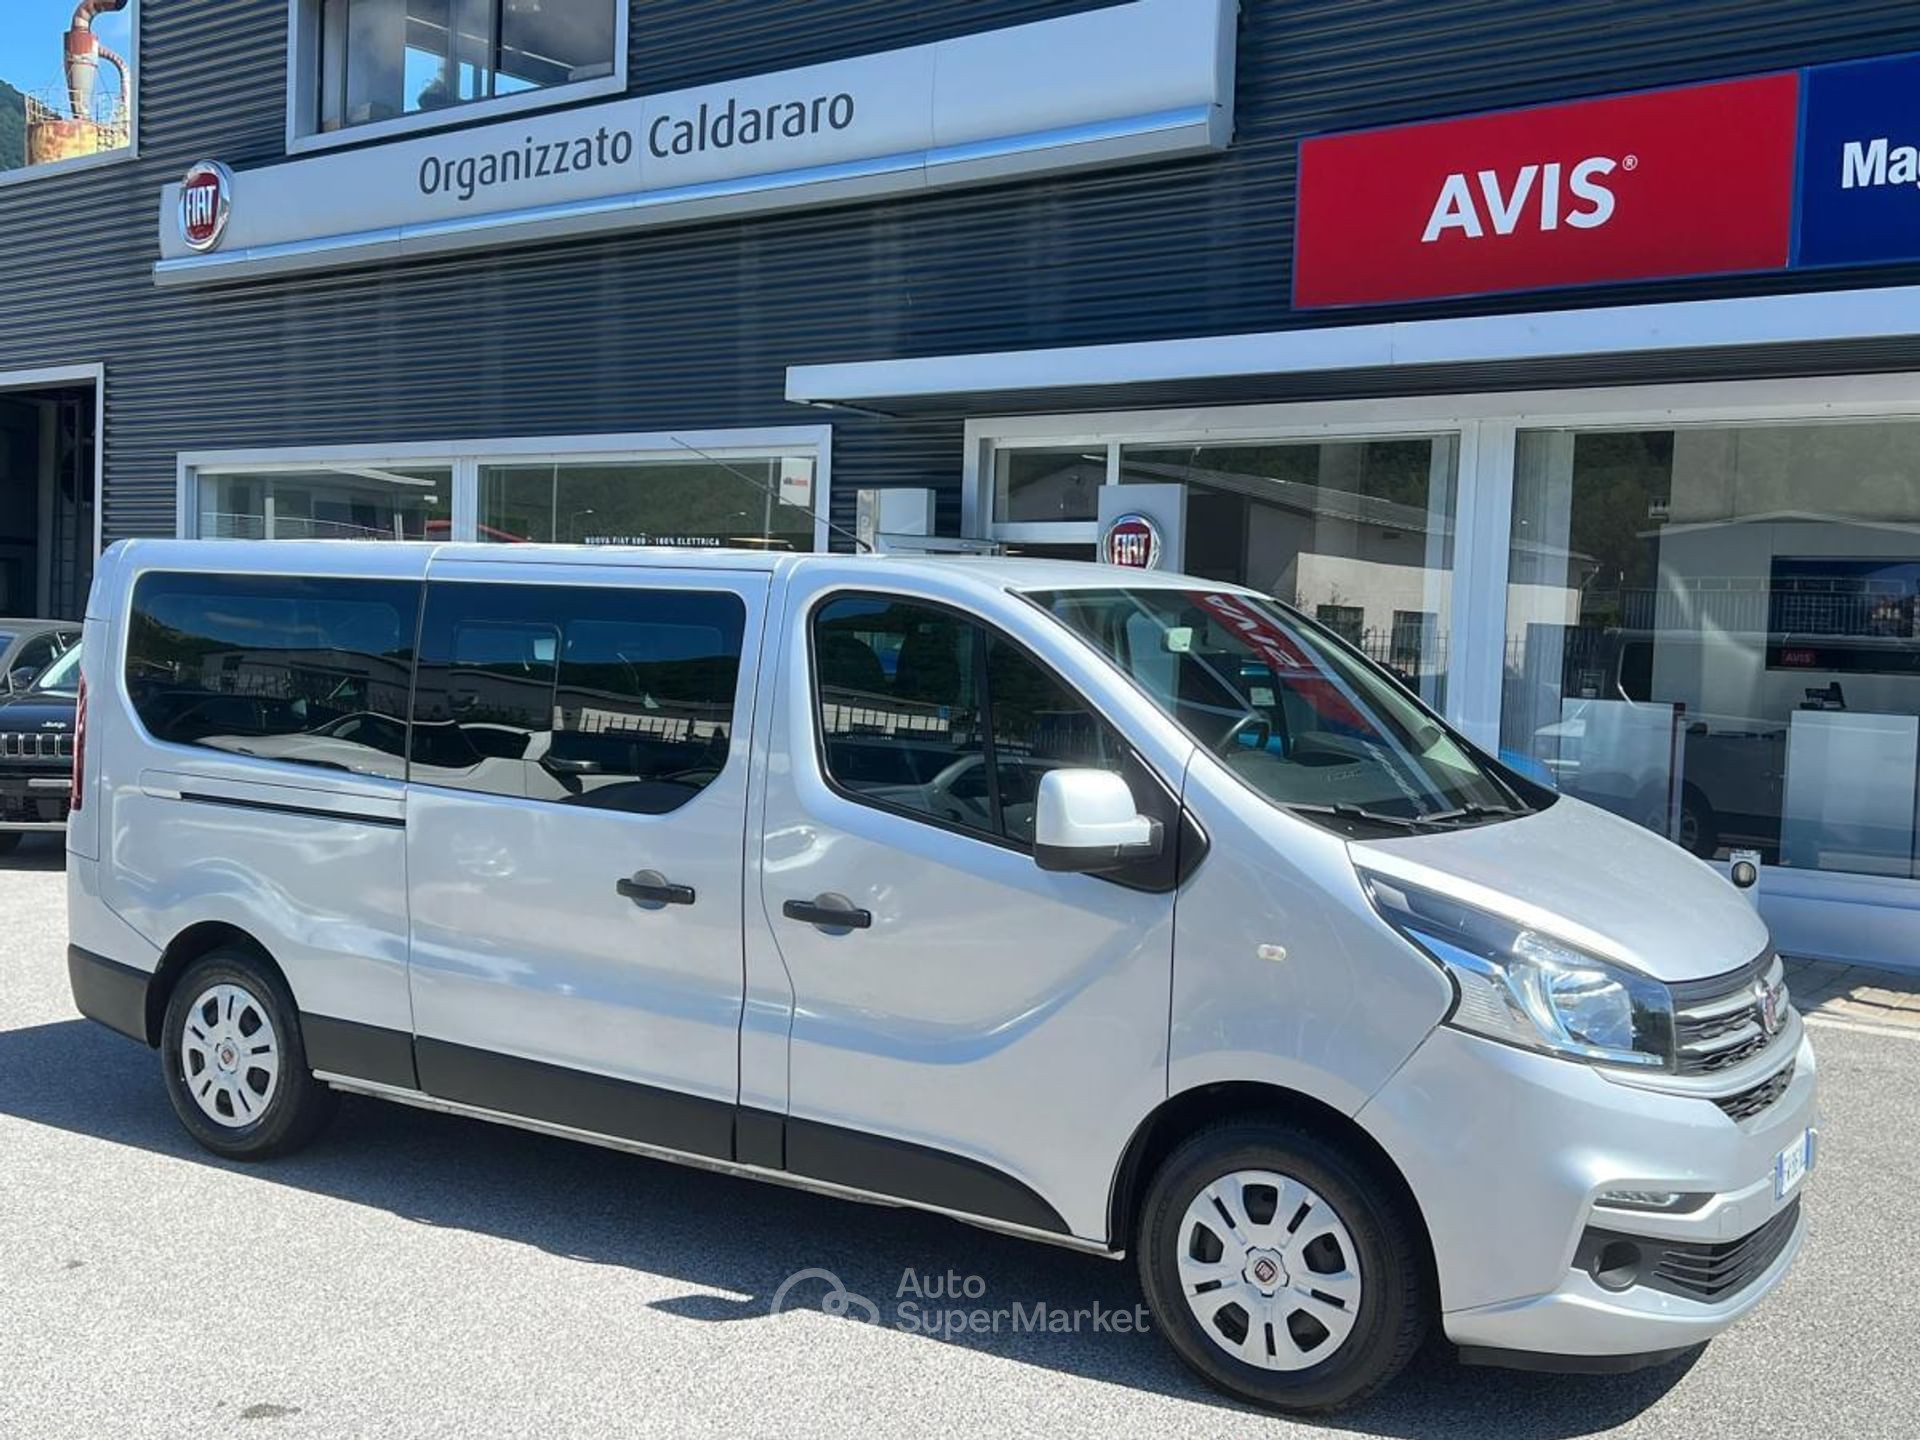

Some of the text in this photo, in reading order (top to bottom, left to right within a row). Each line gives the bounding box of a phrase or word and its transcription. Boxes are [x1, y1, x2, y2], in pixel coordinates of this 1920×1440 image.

[419, 92, 855, 201] Organizzato Caldararo
[1842, 138, 1920, 189] Ma
[185, 184, 217, 228] FIAT
[612, 536, 630, 545] FIAT
[677, 536, 720, 546] ELETTRICA
[1113, 533, 1149, 565] FIAT
[1785, 652, 1811, 663] AVIS
